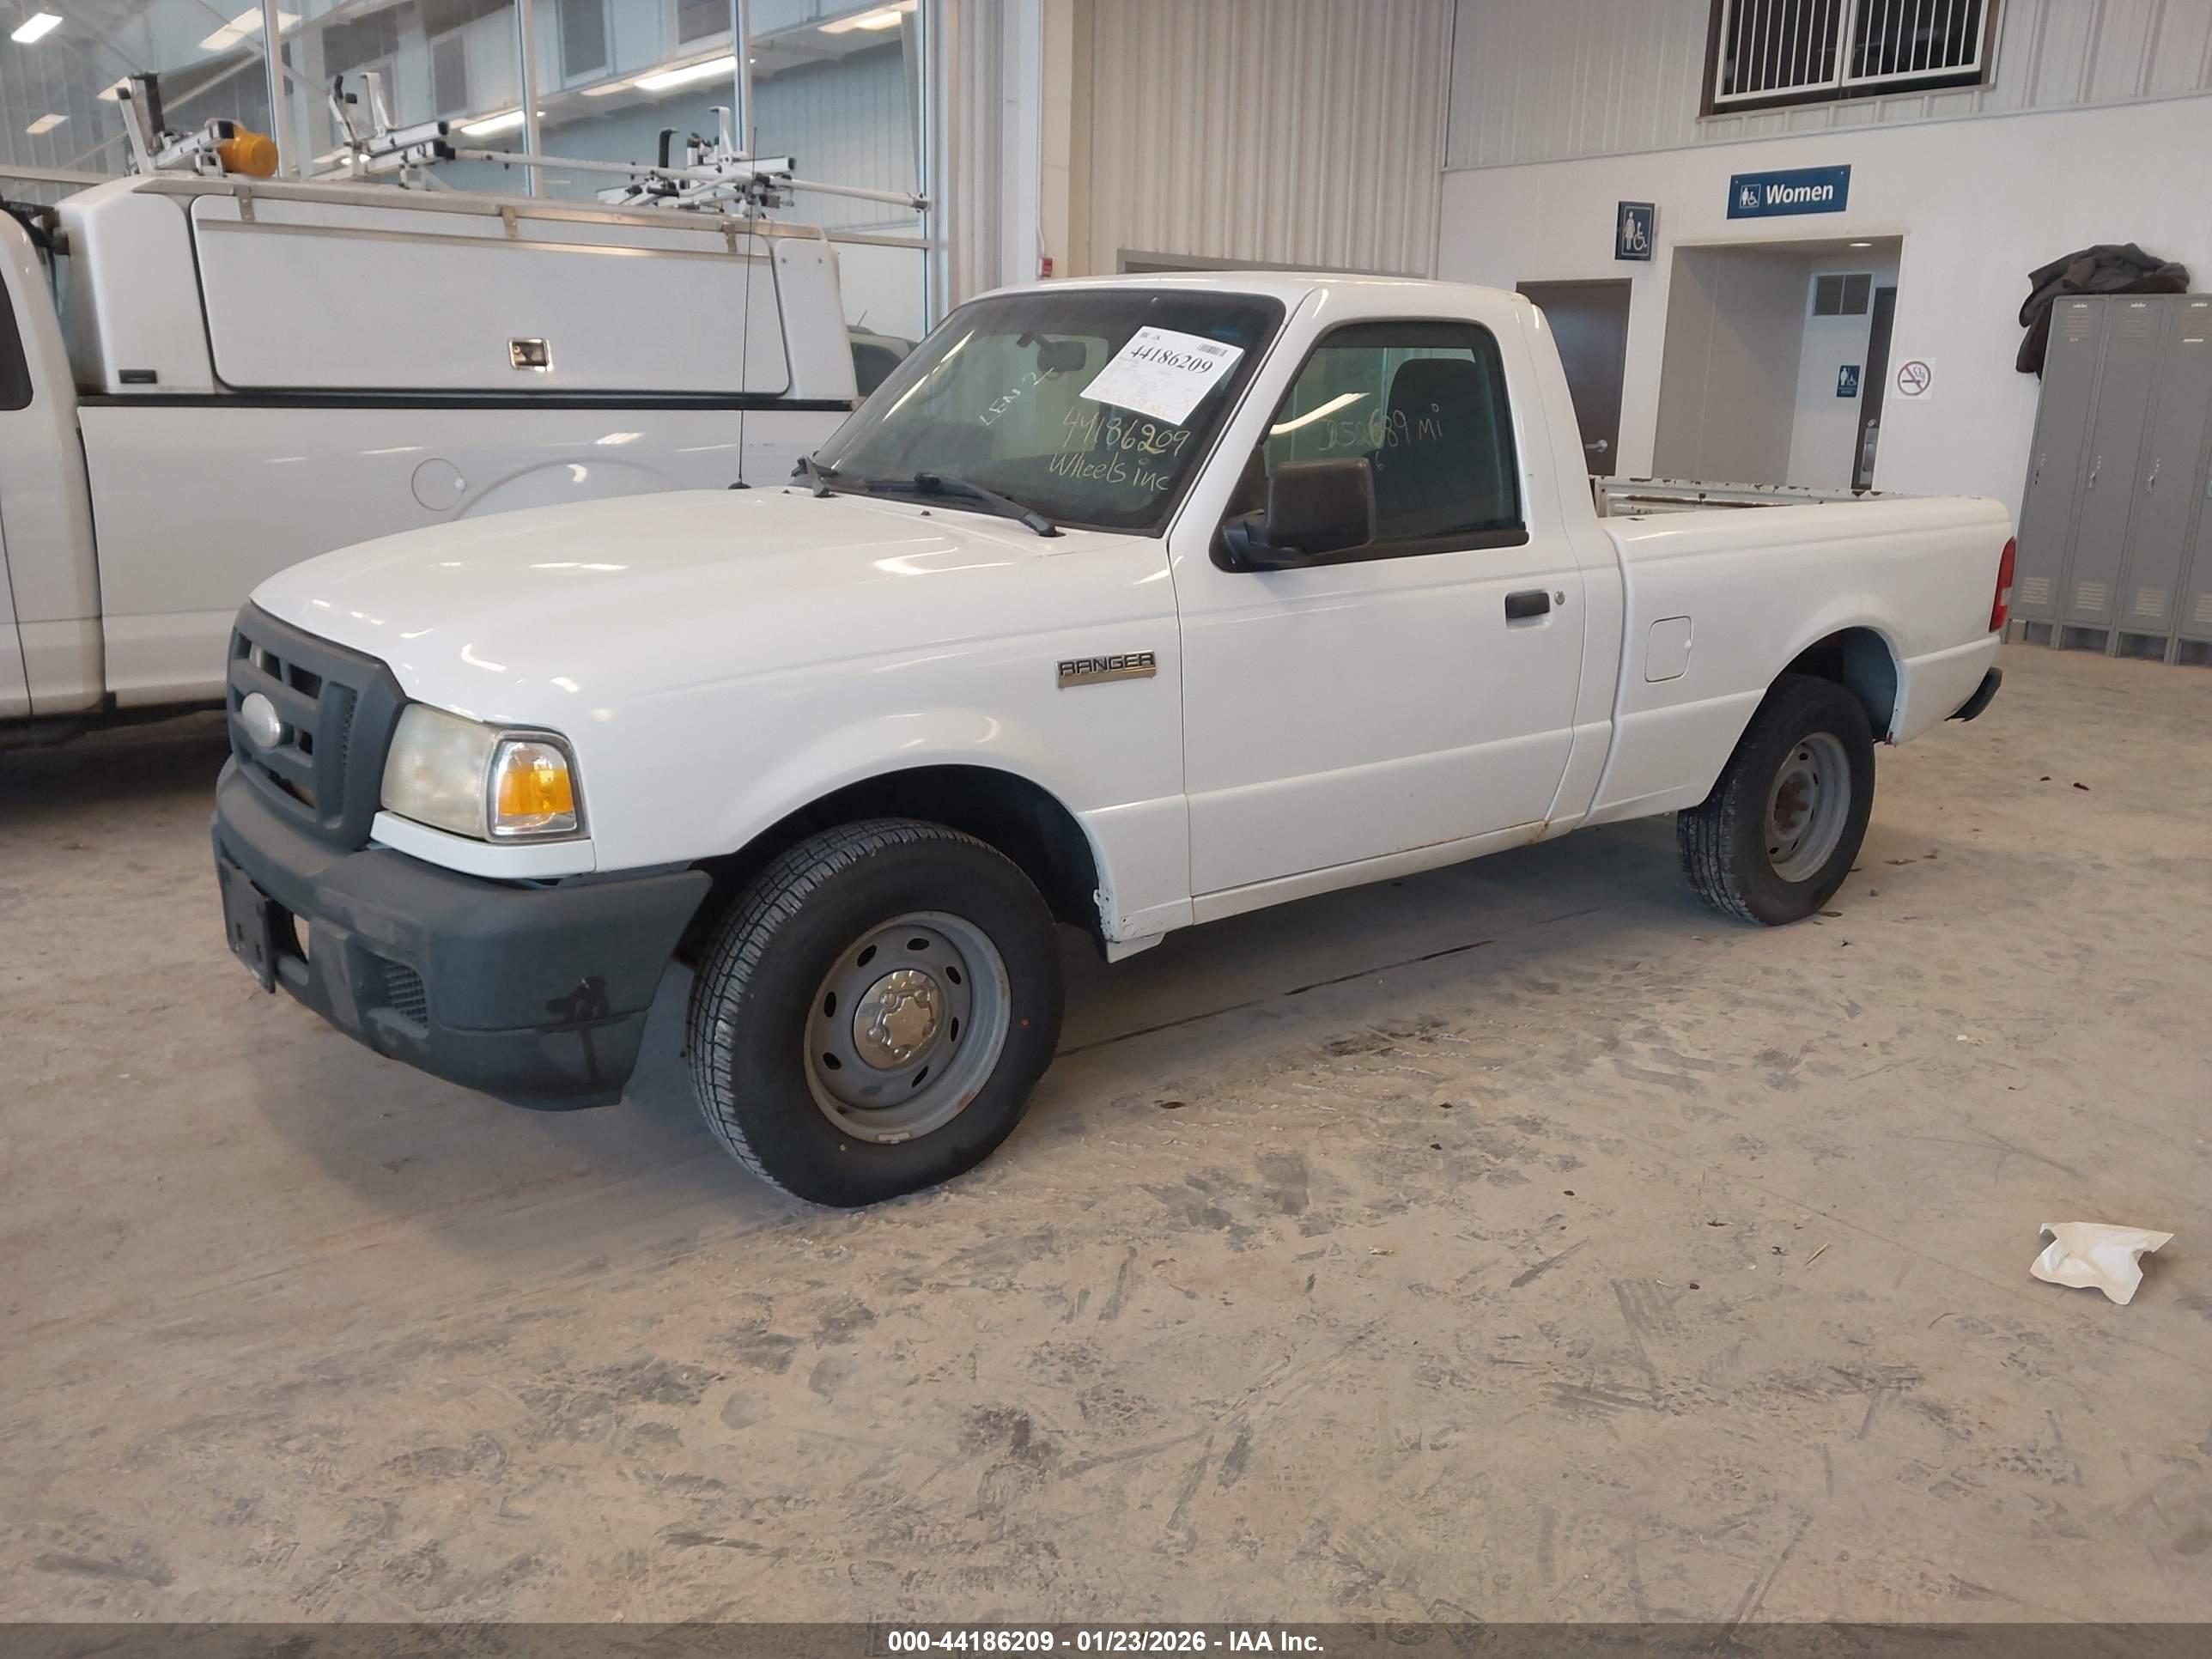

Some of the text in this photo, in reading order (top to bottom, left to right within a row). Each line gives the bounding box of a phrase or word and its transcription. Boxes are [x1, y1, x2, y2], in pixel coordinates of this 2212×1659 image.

[1766, 183, 1833, 204] Women
[1130, 344, 1213, 374] 44186209
[1062, 405, 1191, 459] 44186209
[1059, 653, 1155, 676] RANGER
